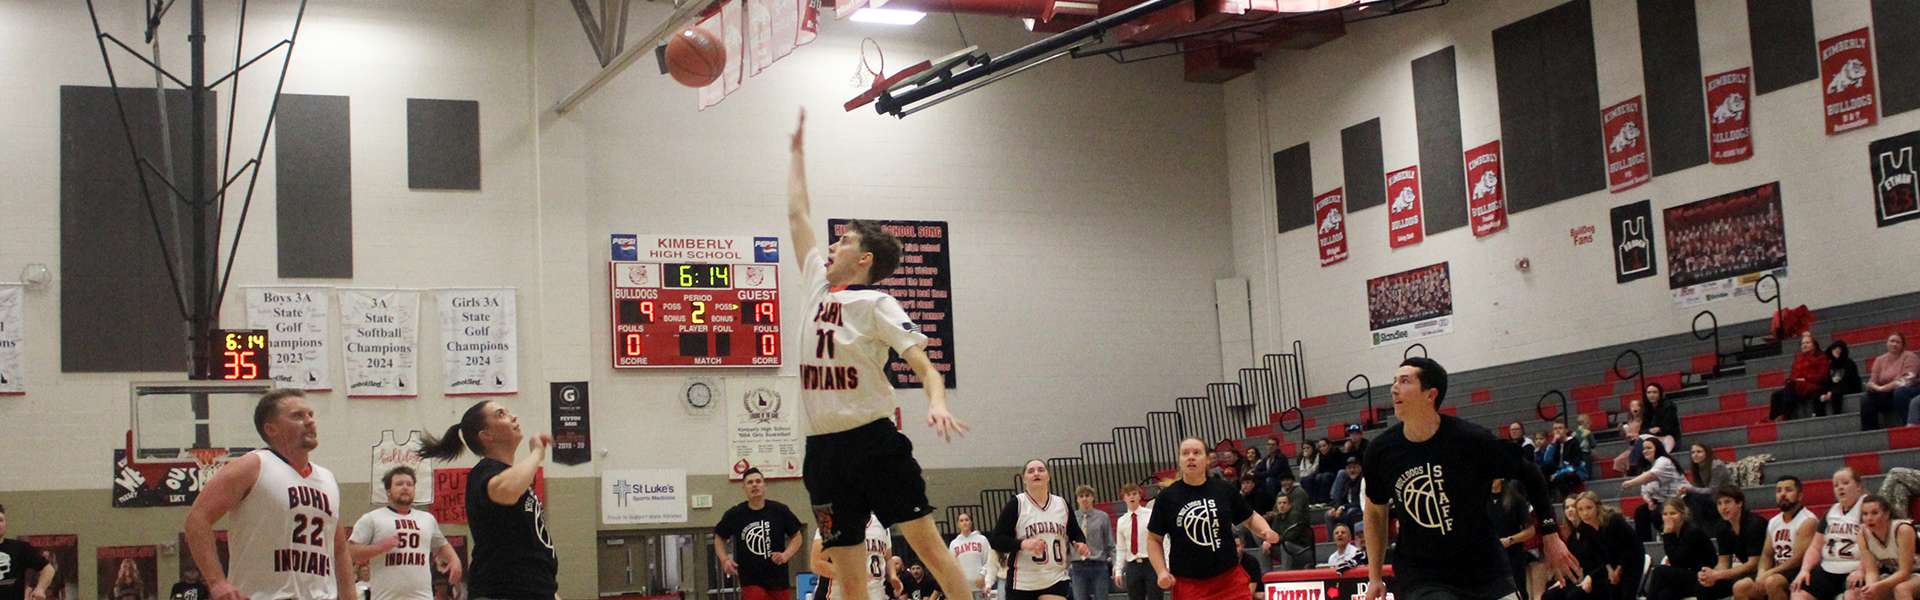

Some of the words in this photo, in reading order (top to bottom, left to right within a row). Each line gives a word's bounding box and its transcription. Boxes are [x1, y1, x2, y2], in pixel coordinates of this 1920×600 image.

[1824, 38, 1866, 61] KIMBERLY
[1708, 74, 1746, 92] KIMBERLY
[1827, 94, 1872, 116] BULLDOGS
[1604, 103, 1638, 123] KIMBERLY
[1712, 128, 1750, 144] BULLDOGS
[1469, 154, 1497, 170] KIMBERLY
[1610, 152, 1644, 172] BULLDOGS
[1388, 170, 1415, 186] KIMBERLY
[1472, 201, 1502, 216] BULLDOGS
[1392, 215, 1418, 230] BULLDOGS
[918, 226, 942, 238] SONG
[1570, 225, 1595, 236] BullDog
[658, 239, 733, 249] KIMBERLY
[1320, 232, 1343, 246] BULLDOGS
[1574, 235, 1592, 245] Fans
[650, 250, 682, 259] HIGH
[686, 251, 741, 260] SCHOOL
[680, 266, 728, 286] 6:14
[264, 293, 292, 305] Boys
[296, 292, 312, 303] 3A
[615, 289, 658, 299] BULLDOGS
[738, 290, 776, 300] GUEST
[371, 298, 387, 308] 3A
[452, 297, 480, 308] Girls
[484, 297, 499, 307] 3A
[273, 308, 303, 317] State
[365, 314, 394, 323] State
[462, 312, 490, 322] State
[640, 302, 654, 322] 9
[692, 301, 705, 324] 2
[756, 302, 774, 322] 19
[276, 322, 303, 332] Golf
[358, 328, 401, 338] Softball
[464, 326, 490, 336] Golf
[226, 333, 264, 350] 6:14
[270, 338, 322, 349] hampions
[447, 341, 509, 353] Champions
[627, 334, 640, 356] 0
[762, 334, 774, 355] 0
[816, 329, 835, 358] 11
[347, 342, 411, 355] Champions
[276, 353, 303, 363] 2023
[367, 358, 393, 368] 2024
[466, 356, 490, 366] 2024
[224, 351, 257, 379] 35
[564, 389, 575, 402] G
[633, 484, 643, 493] St
[645, 484, 674, 493] Luke's
[288, 486, 332, 517] BUHL
[442, 494, 463, 505] THE
[1433, 465, 1454, 531] STAFF
[292, 514, 324, 547] 22
[395, 519, 420, 530] BUHL
[1208, 500, 1222, 548] STAFF
[397, 533, 420, 548] 50
[385, 552, 425, 566] INDIANS
